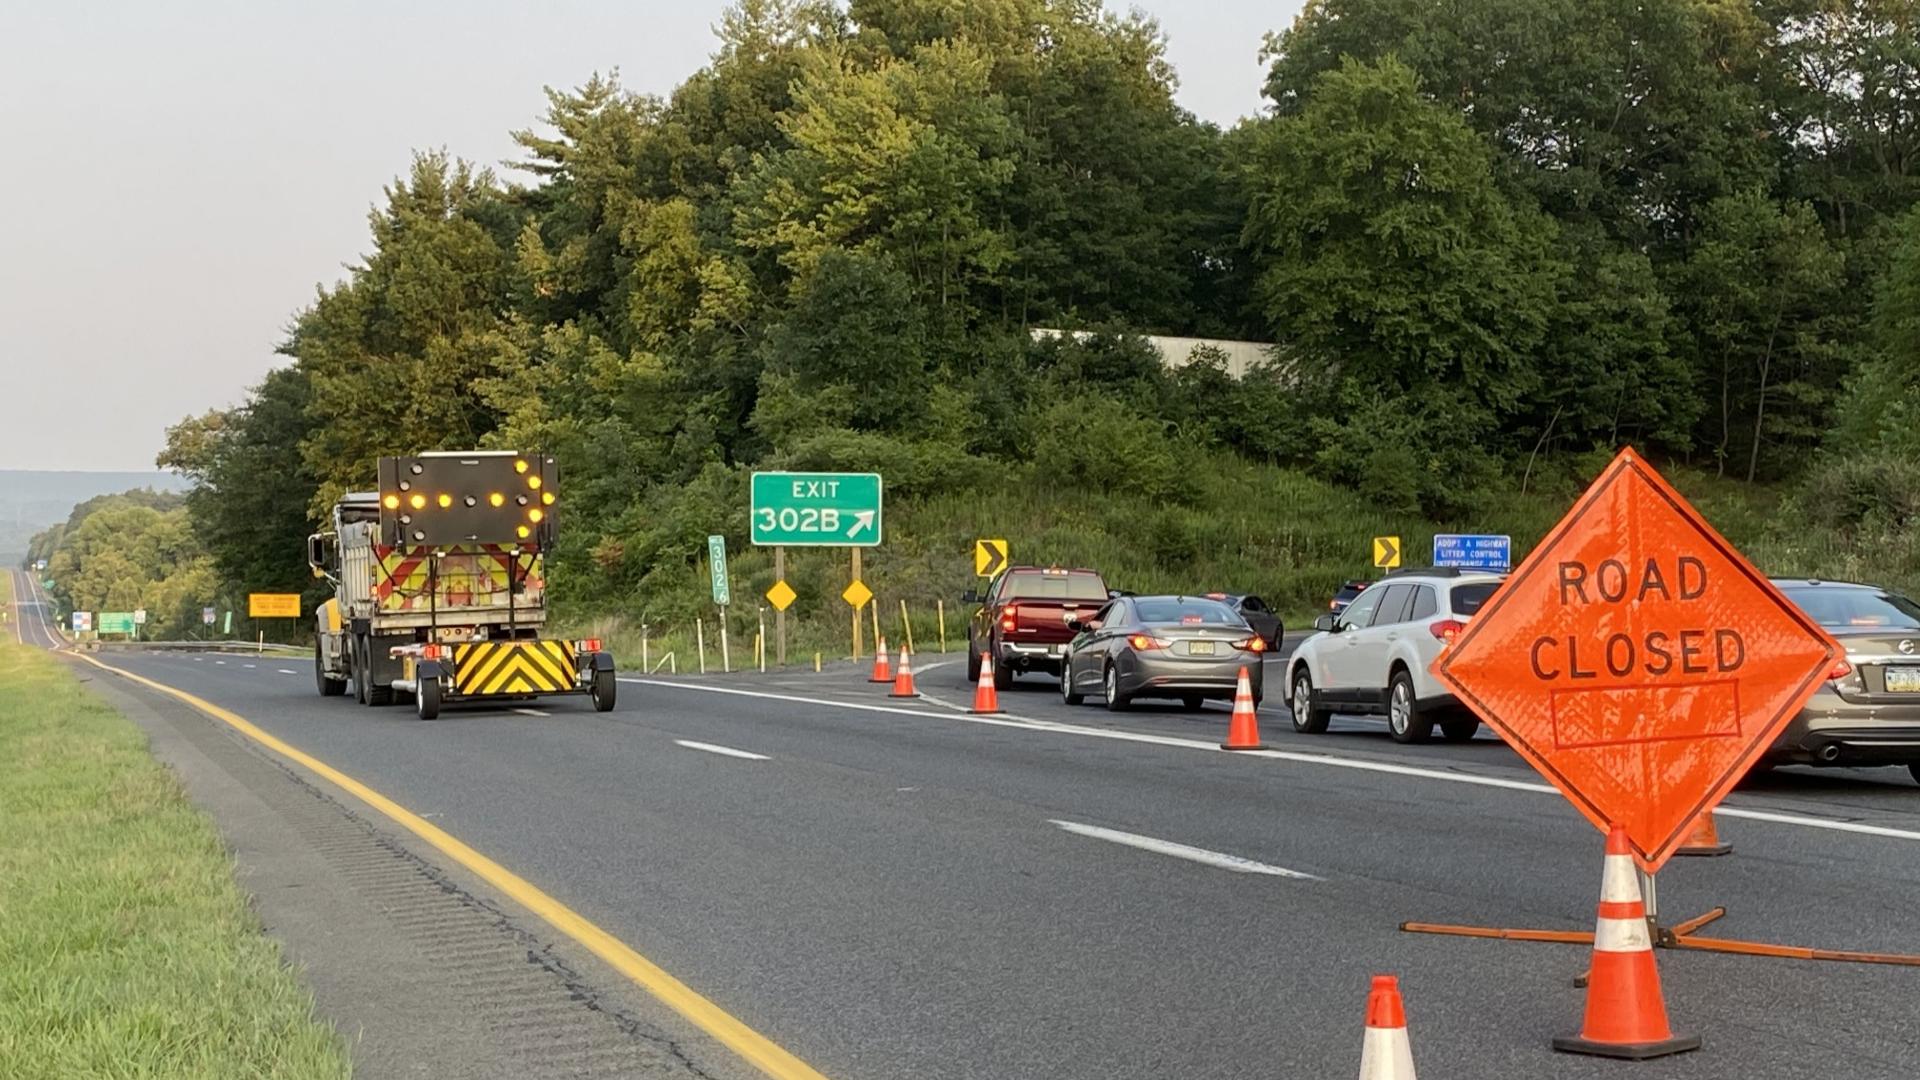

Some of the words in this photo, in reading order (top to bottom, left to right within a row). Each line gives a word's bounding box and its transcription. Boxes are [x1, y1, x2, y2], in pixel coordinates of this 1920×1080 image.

[792, 481, 840, 498] EXIT
[758, 507, 840, 532] 302B
[1437, 539, 1461, 548] ADOPT
[1466, 539, 1472, 548] A
[1476, 540, 1507, 548] HIGHWAY
[1441, 550, 1466, 558] LITTER
[1470, 550, 1503, 559] CONTROL
[1558, 556, 1708, 605] ROAD
[1530, 629, 1745, 680] CLOSED
